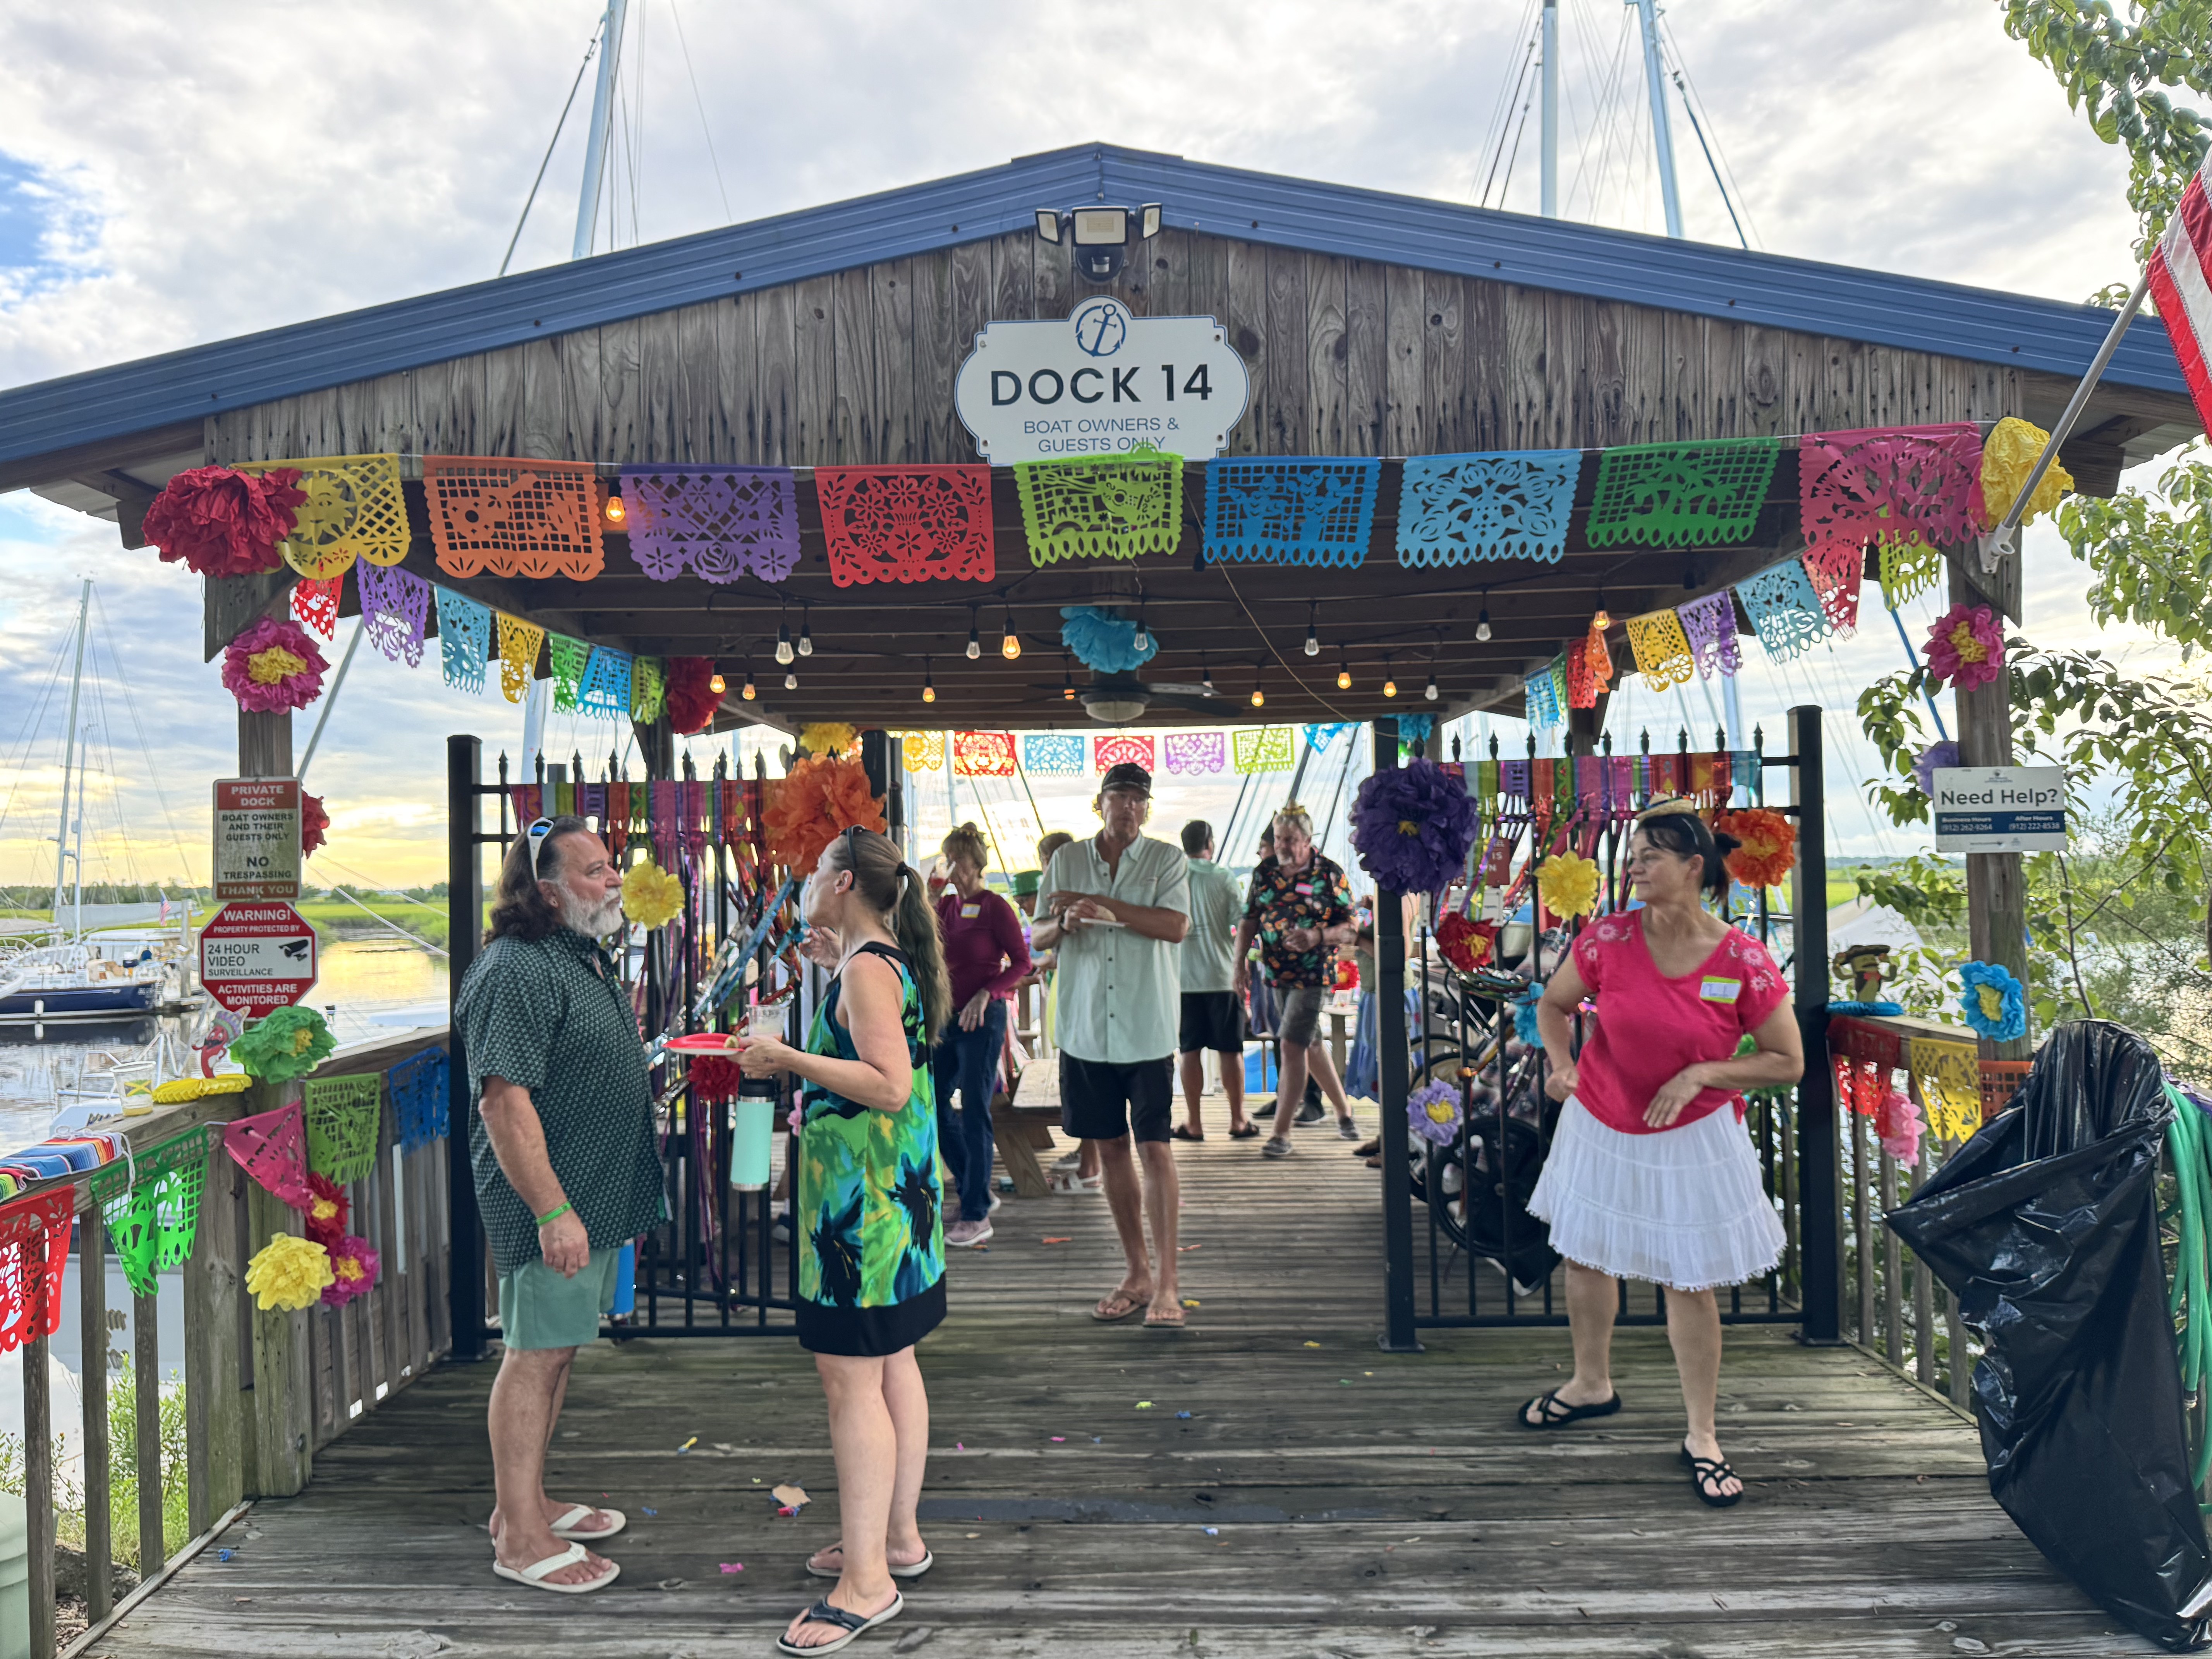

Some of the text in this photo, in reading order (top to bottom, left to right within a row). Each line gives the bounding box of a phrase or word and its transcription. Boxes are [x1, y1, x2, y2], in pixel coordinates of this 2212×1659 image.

[991, 364, 1212, 405] DOCK 14
[1024, 417, 1180, 434] BOAT OWNERS &
[1038, 436, 1166, 452] GUESTS ONLY
[231, 785, 284, 795] PRIVATE
[240, 797, 276, 806] DOCK
[1941, 788, 2058, 807] Need Help?
[226, 832, 290, 842] GUESTS ONLY
[246, 856, 269, 867] NO
[223, 871, 292, 880] TRESPASSING
[220, 884, 294, 895] THANK YOU
[223, 909, 290, 921] WARNING!
[249, 925, 289, 933] PROTECTED
[208, 943, 259, 954] 24 HOUR
[208, 956, 245, 966] VIDEO
[208, 968, 273, 976] SURVEILLANCE
[218, 983, 297, 994] ACTIVITIES ARE
[227, 995, 289, 1005] MONITORED
